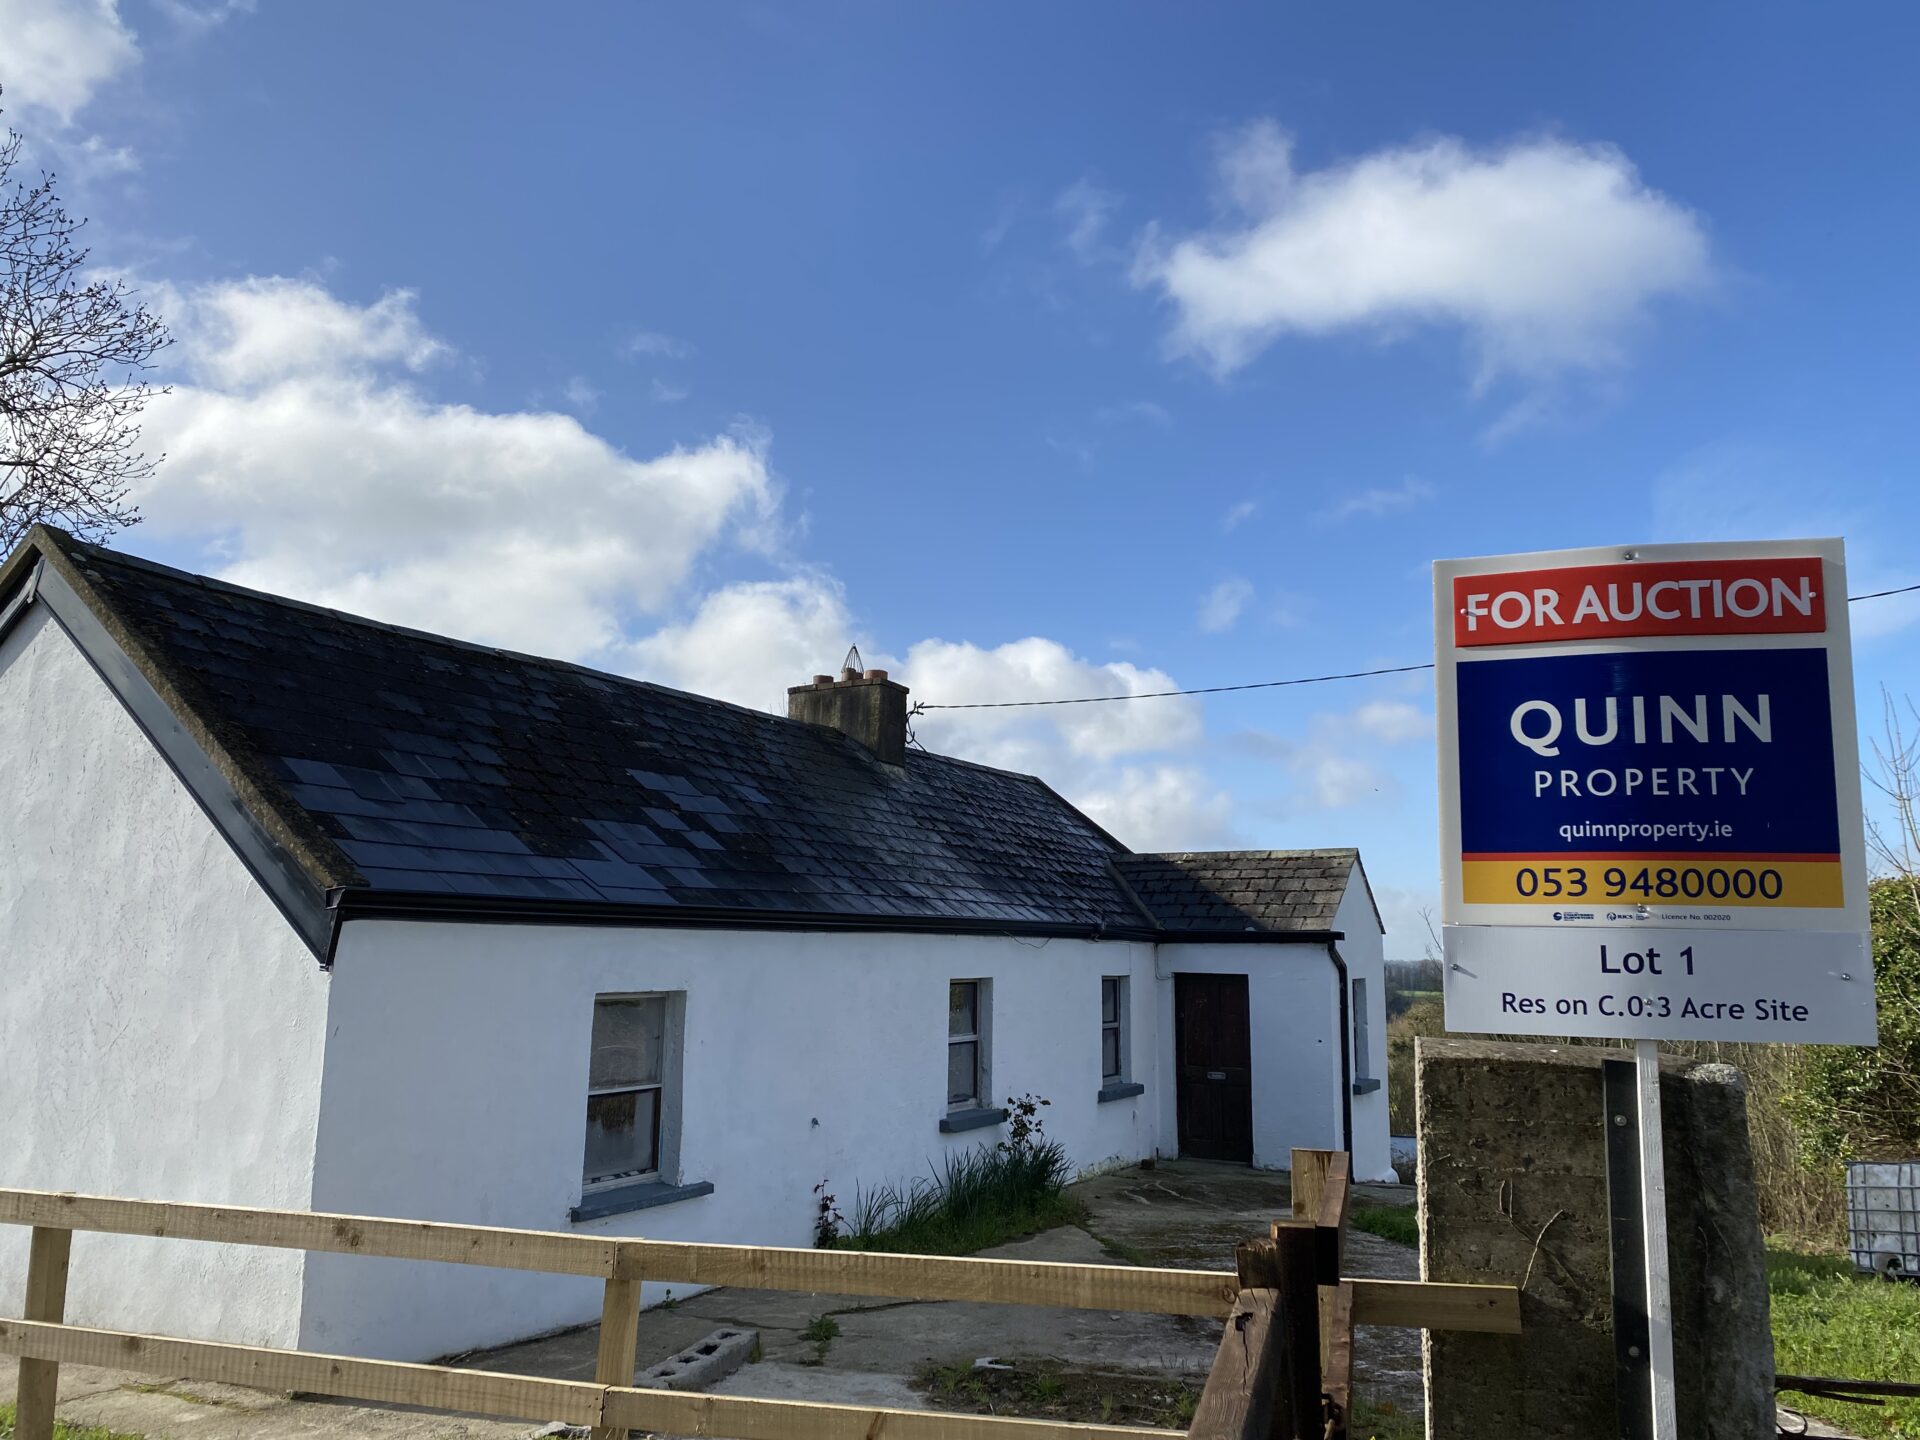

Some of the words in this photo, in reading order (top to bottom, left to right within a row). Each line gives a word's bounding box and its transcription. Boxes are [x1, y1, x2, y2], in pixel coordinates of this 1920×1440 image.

[1467, 588, 1564, 631] FOR
[1572, 576, 1812, 625] AUCTION
[1510, 694, 1772, 757] QUINN
[1535, 767, 1754, 798] PROPERTY
[1559, 820, 1733, 842] quinnproperty.ie
[1515, 867, 1588, 897] 053
[1603, 867, 1783, 899] 9480000
[1600, 944, 1662, 975] Lot
[1680, 946, 1694, 975] 1
[1502, 993, 1546, 1014] Res
[1556, 998, 1588, 1015] on
[1681, 997, 1745, 1019] Acre
[1756, 999, 1809, 1022] Site
